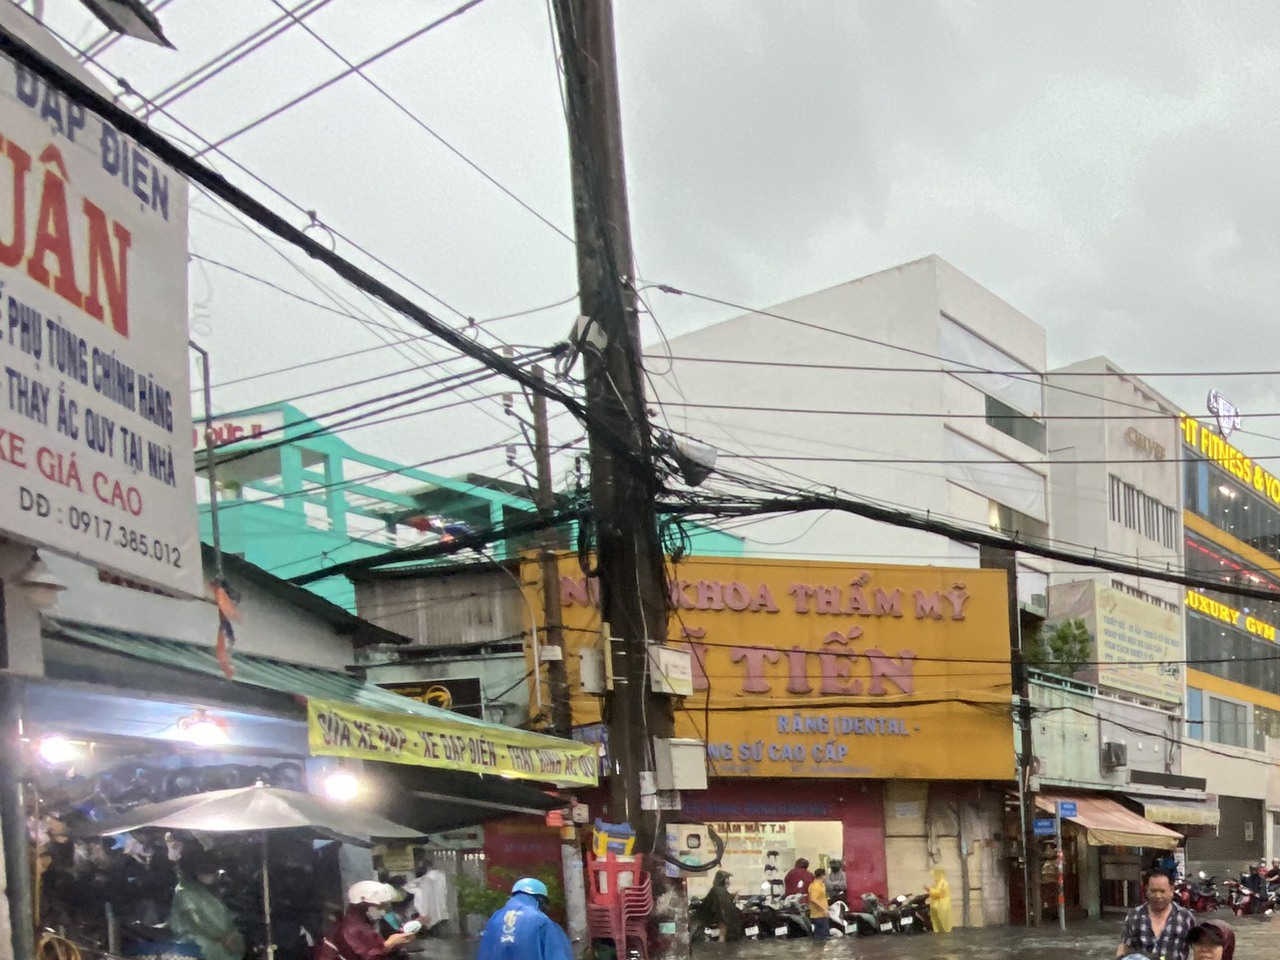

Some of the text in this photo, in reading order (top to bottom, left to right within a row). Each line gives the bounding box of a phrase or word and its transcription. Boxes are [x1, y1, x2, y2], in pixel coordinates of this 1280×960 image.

[8, 295, 43, 371] PHỤ
[46, 316, 89, 386] TÙNG
[92, 346, 136, 412] CHÍNH
[138, 372, 173, 433] HÀNG
[5, 366, 50, 425] THAY
[85, 407, 115, 458] QUY
[120, 426, 143, 475] TẠI
[148, 443, 176, 488] NHÀ
[1201, 426, 1251, 484] FITNESS
[37, 447, 83, 493] GIÁ
[92, 471, 142, 517] CAO
[69, 506, 182, 568] 0917.385.012
[668, 571, 970, 620] KHOA THẨM MỸ
[1246, 616, 1275, 641] GYM
[731, 625, 917, 696] TIẾN
[418, 730, 440, 759] XE
[739, 740, 764, 762] SỨ
[767, 743, 805, 762] CAO
[811, 739, 848, 763] CẤP
[777, 713, 829, 734] RĂNG
